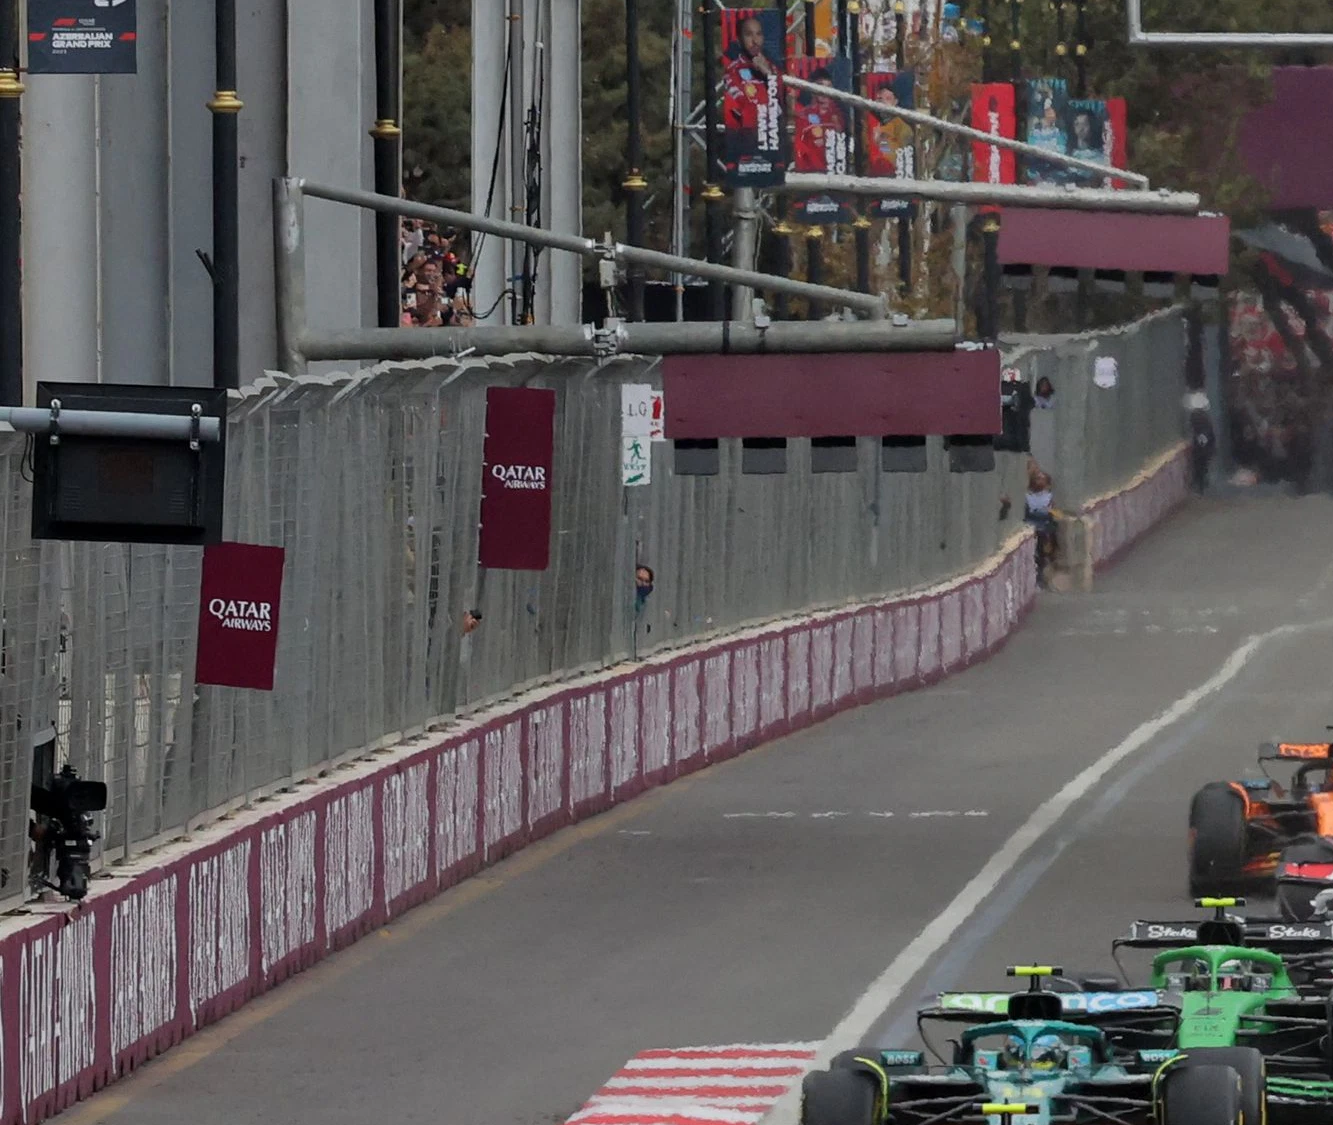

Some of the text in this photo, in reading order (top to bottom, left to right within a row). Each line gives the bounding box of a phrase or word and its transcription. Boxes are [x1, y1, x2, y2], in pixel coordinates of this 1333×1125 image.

[52, 40, 112, 48] GRAND PRIX
[768, 74, 779, 150] HAMILTON
[756, 103, 768, 151] LEWIS
[492, 464, 546, 483] QATAR
[503, 477, 546, 491] AIRWAYS
[209, 598, 272, 622] QATAR
[222, 616, 272, 633] AIRWAYS
[1147, 925, 1197, 939] Stake
[1269, 925, 1321, 939] Stake
